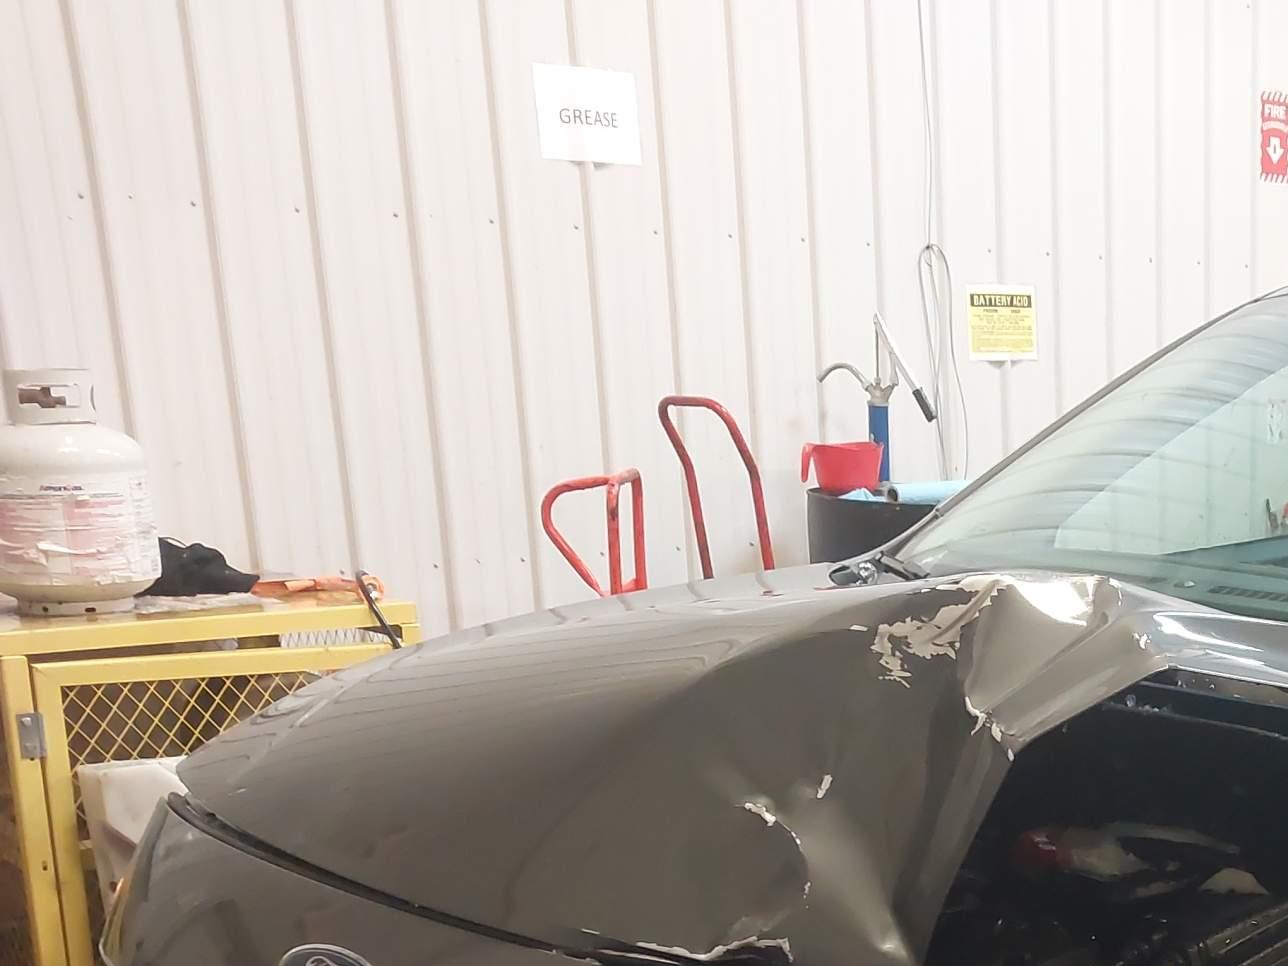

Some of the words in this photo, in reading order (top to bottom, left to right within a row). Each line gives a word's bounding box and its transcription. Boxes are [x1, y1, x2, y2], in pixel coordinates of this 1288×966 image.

[559, 108, 619, 128] GREASE
[1264, 103, 1287, 119] FIRE
[973, 294, 1012, 307] BATTERY
[1012, 295, 1029, 307] ACID
